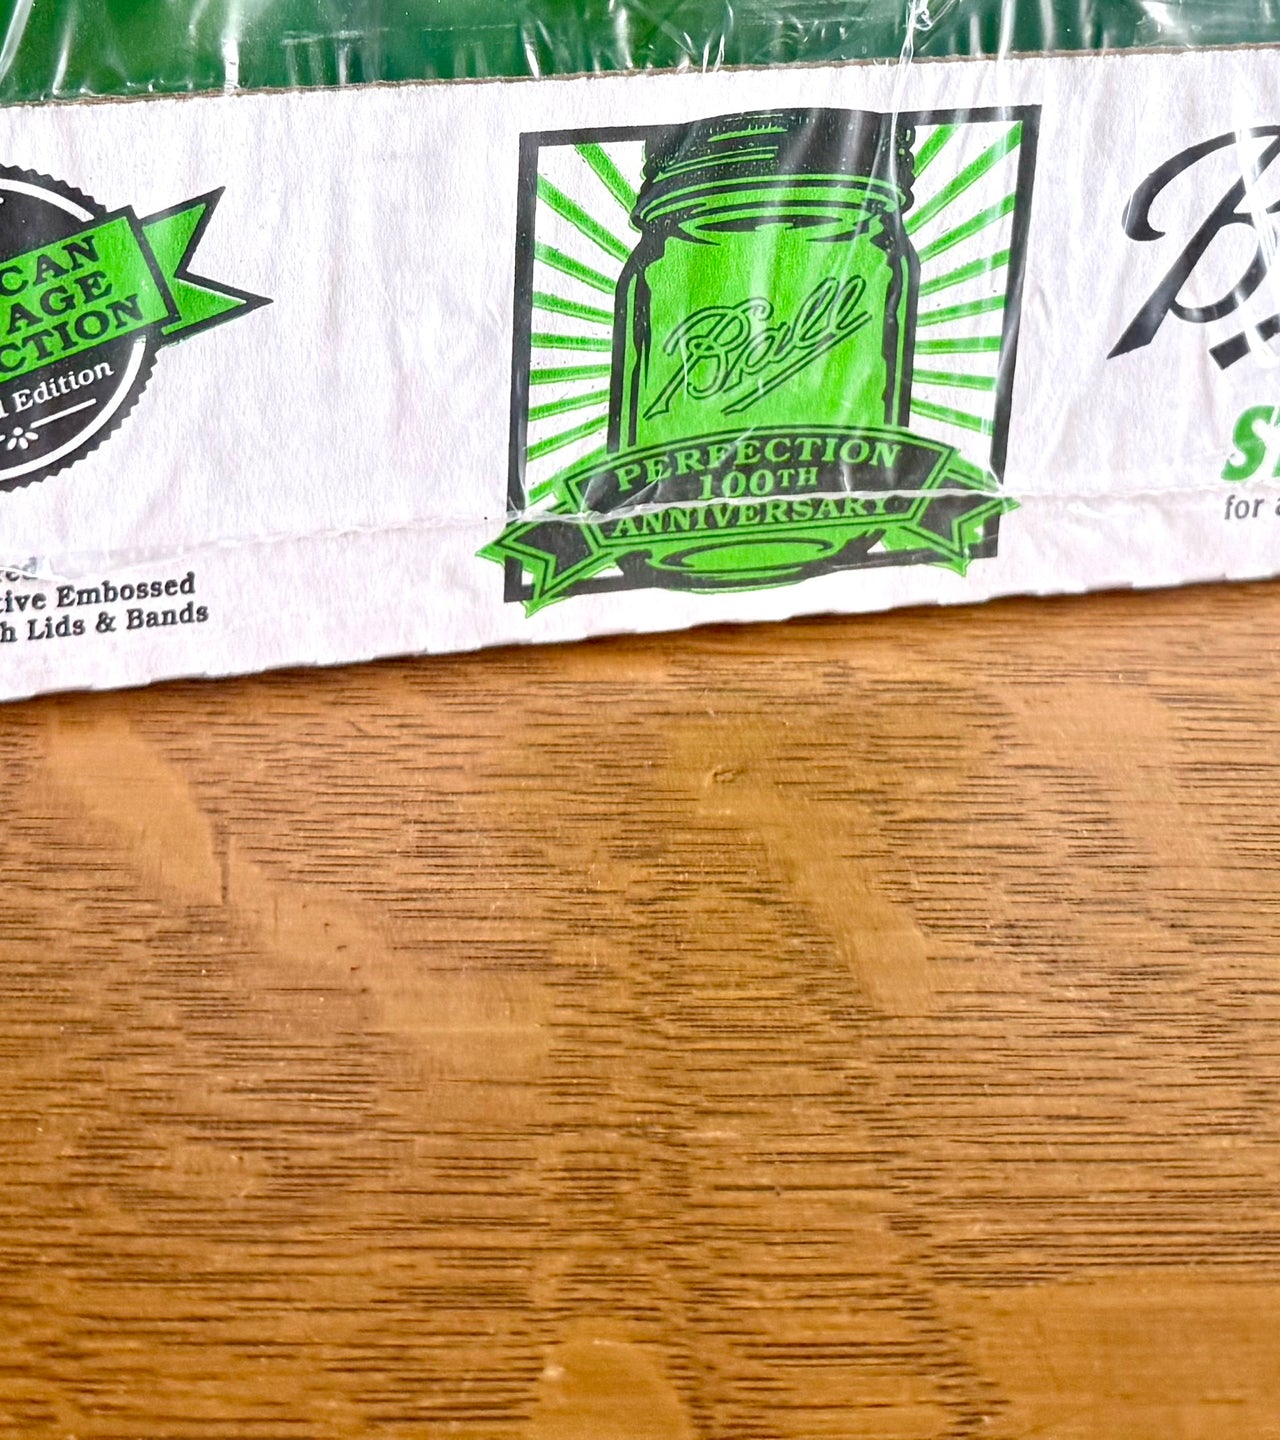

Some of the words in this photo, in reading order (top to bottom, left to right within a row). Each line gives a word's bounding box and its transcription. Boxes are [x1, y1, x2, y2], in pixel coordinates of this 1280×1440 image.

[643, 273, 874, 423] Ball
[11, 360, 115, 411] Edition
[614, 435, 902, 492] PERFECTION
[699, 466, 819, 500] 100TH
[611, 494, 890, 539] ANNIVERSARY
[1223, 493, 1261, 521] for
[55, 570, 197, 608] Embossed
[27, 613, 86, 642] Lids
[94, 611, 118, 634] &
[125, 601, 210, 631] Bands
